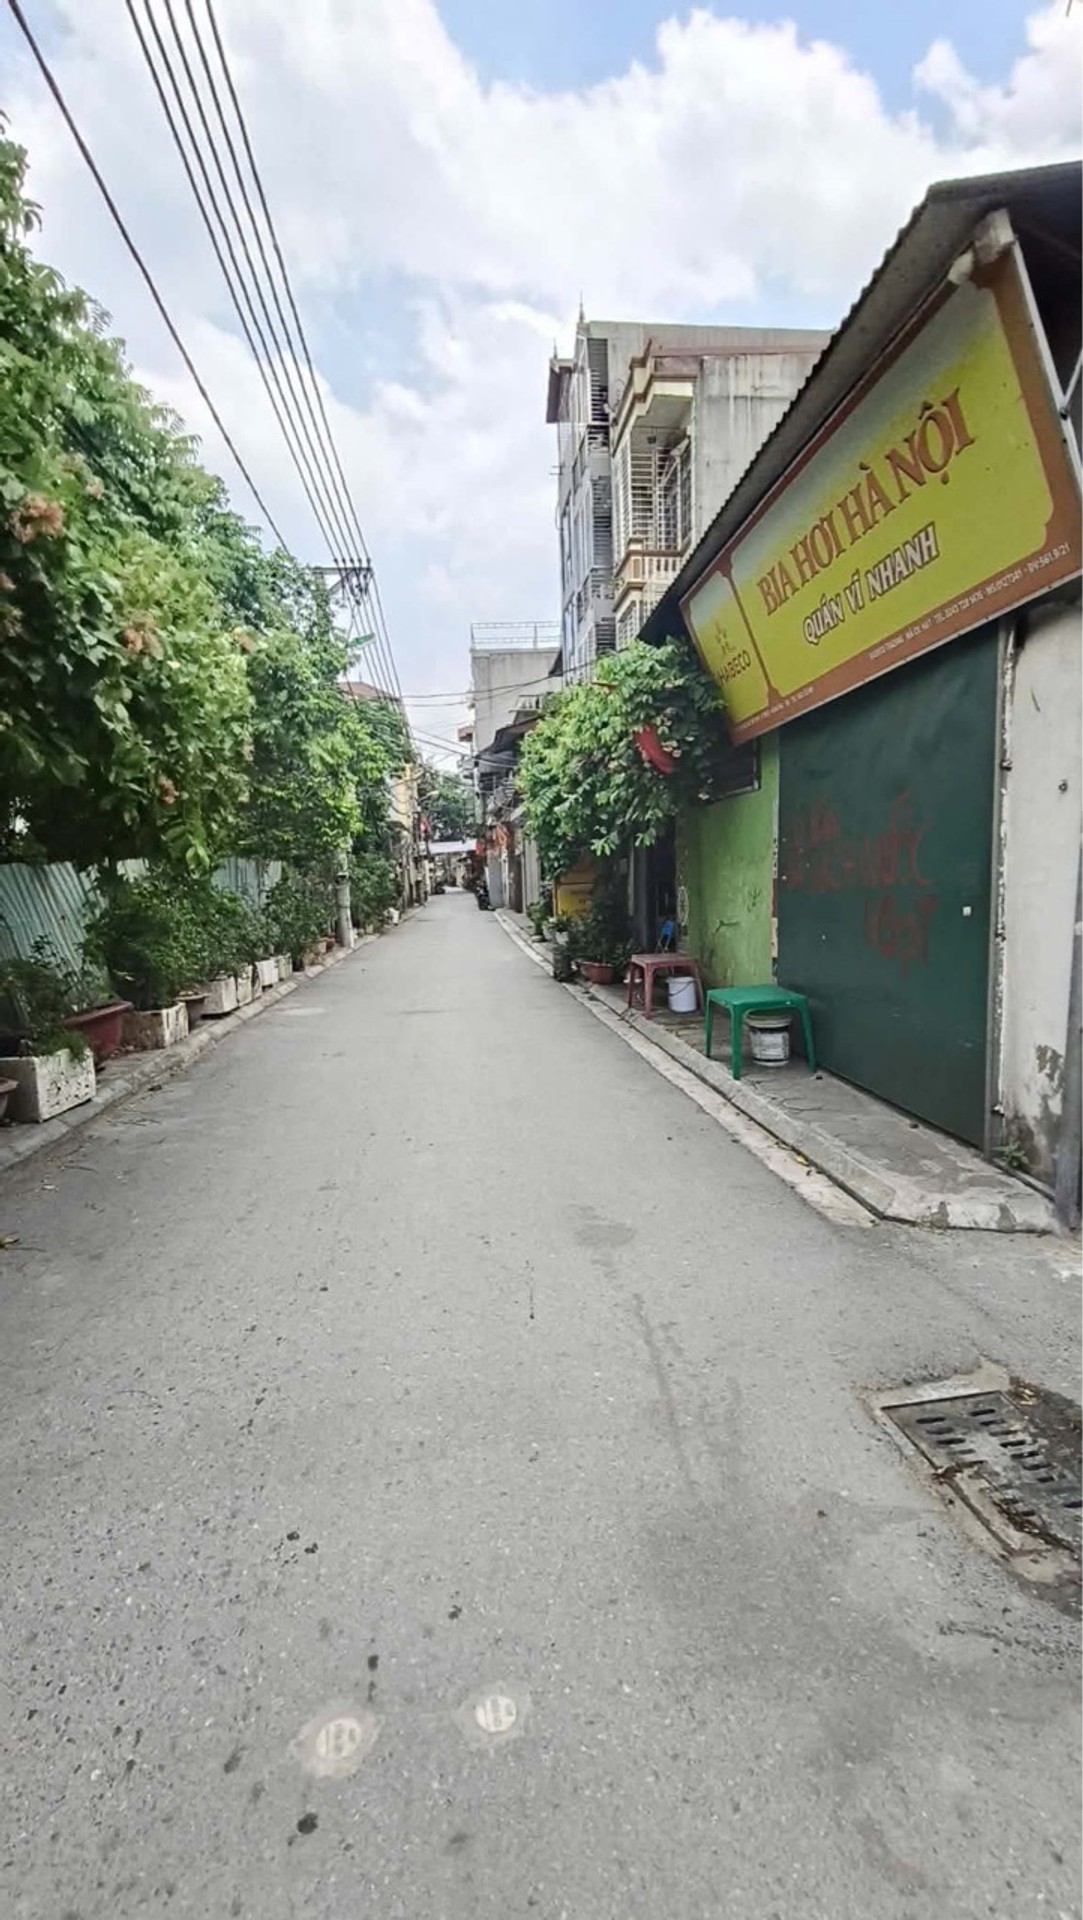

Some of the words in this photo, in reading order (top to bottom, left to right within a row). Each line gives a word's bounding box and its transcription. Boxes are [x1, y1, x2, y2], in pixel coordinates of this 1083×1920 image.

[757, 560, 800, 616] BIA
[789, 510, 846, 587] HƠI
[837, 461, 897, 546] HÀ
[885, 387, 976, 505] NỘI
[803, 593, 846, 646] QUÁN
[865, 520, 940, 602] NHANH
[716, 650, 751, 686] HABECO
